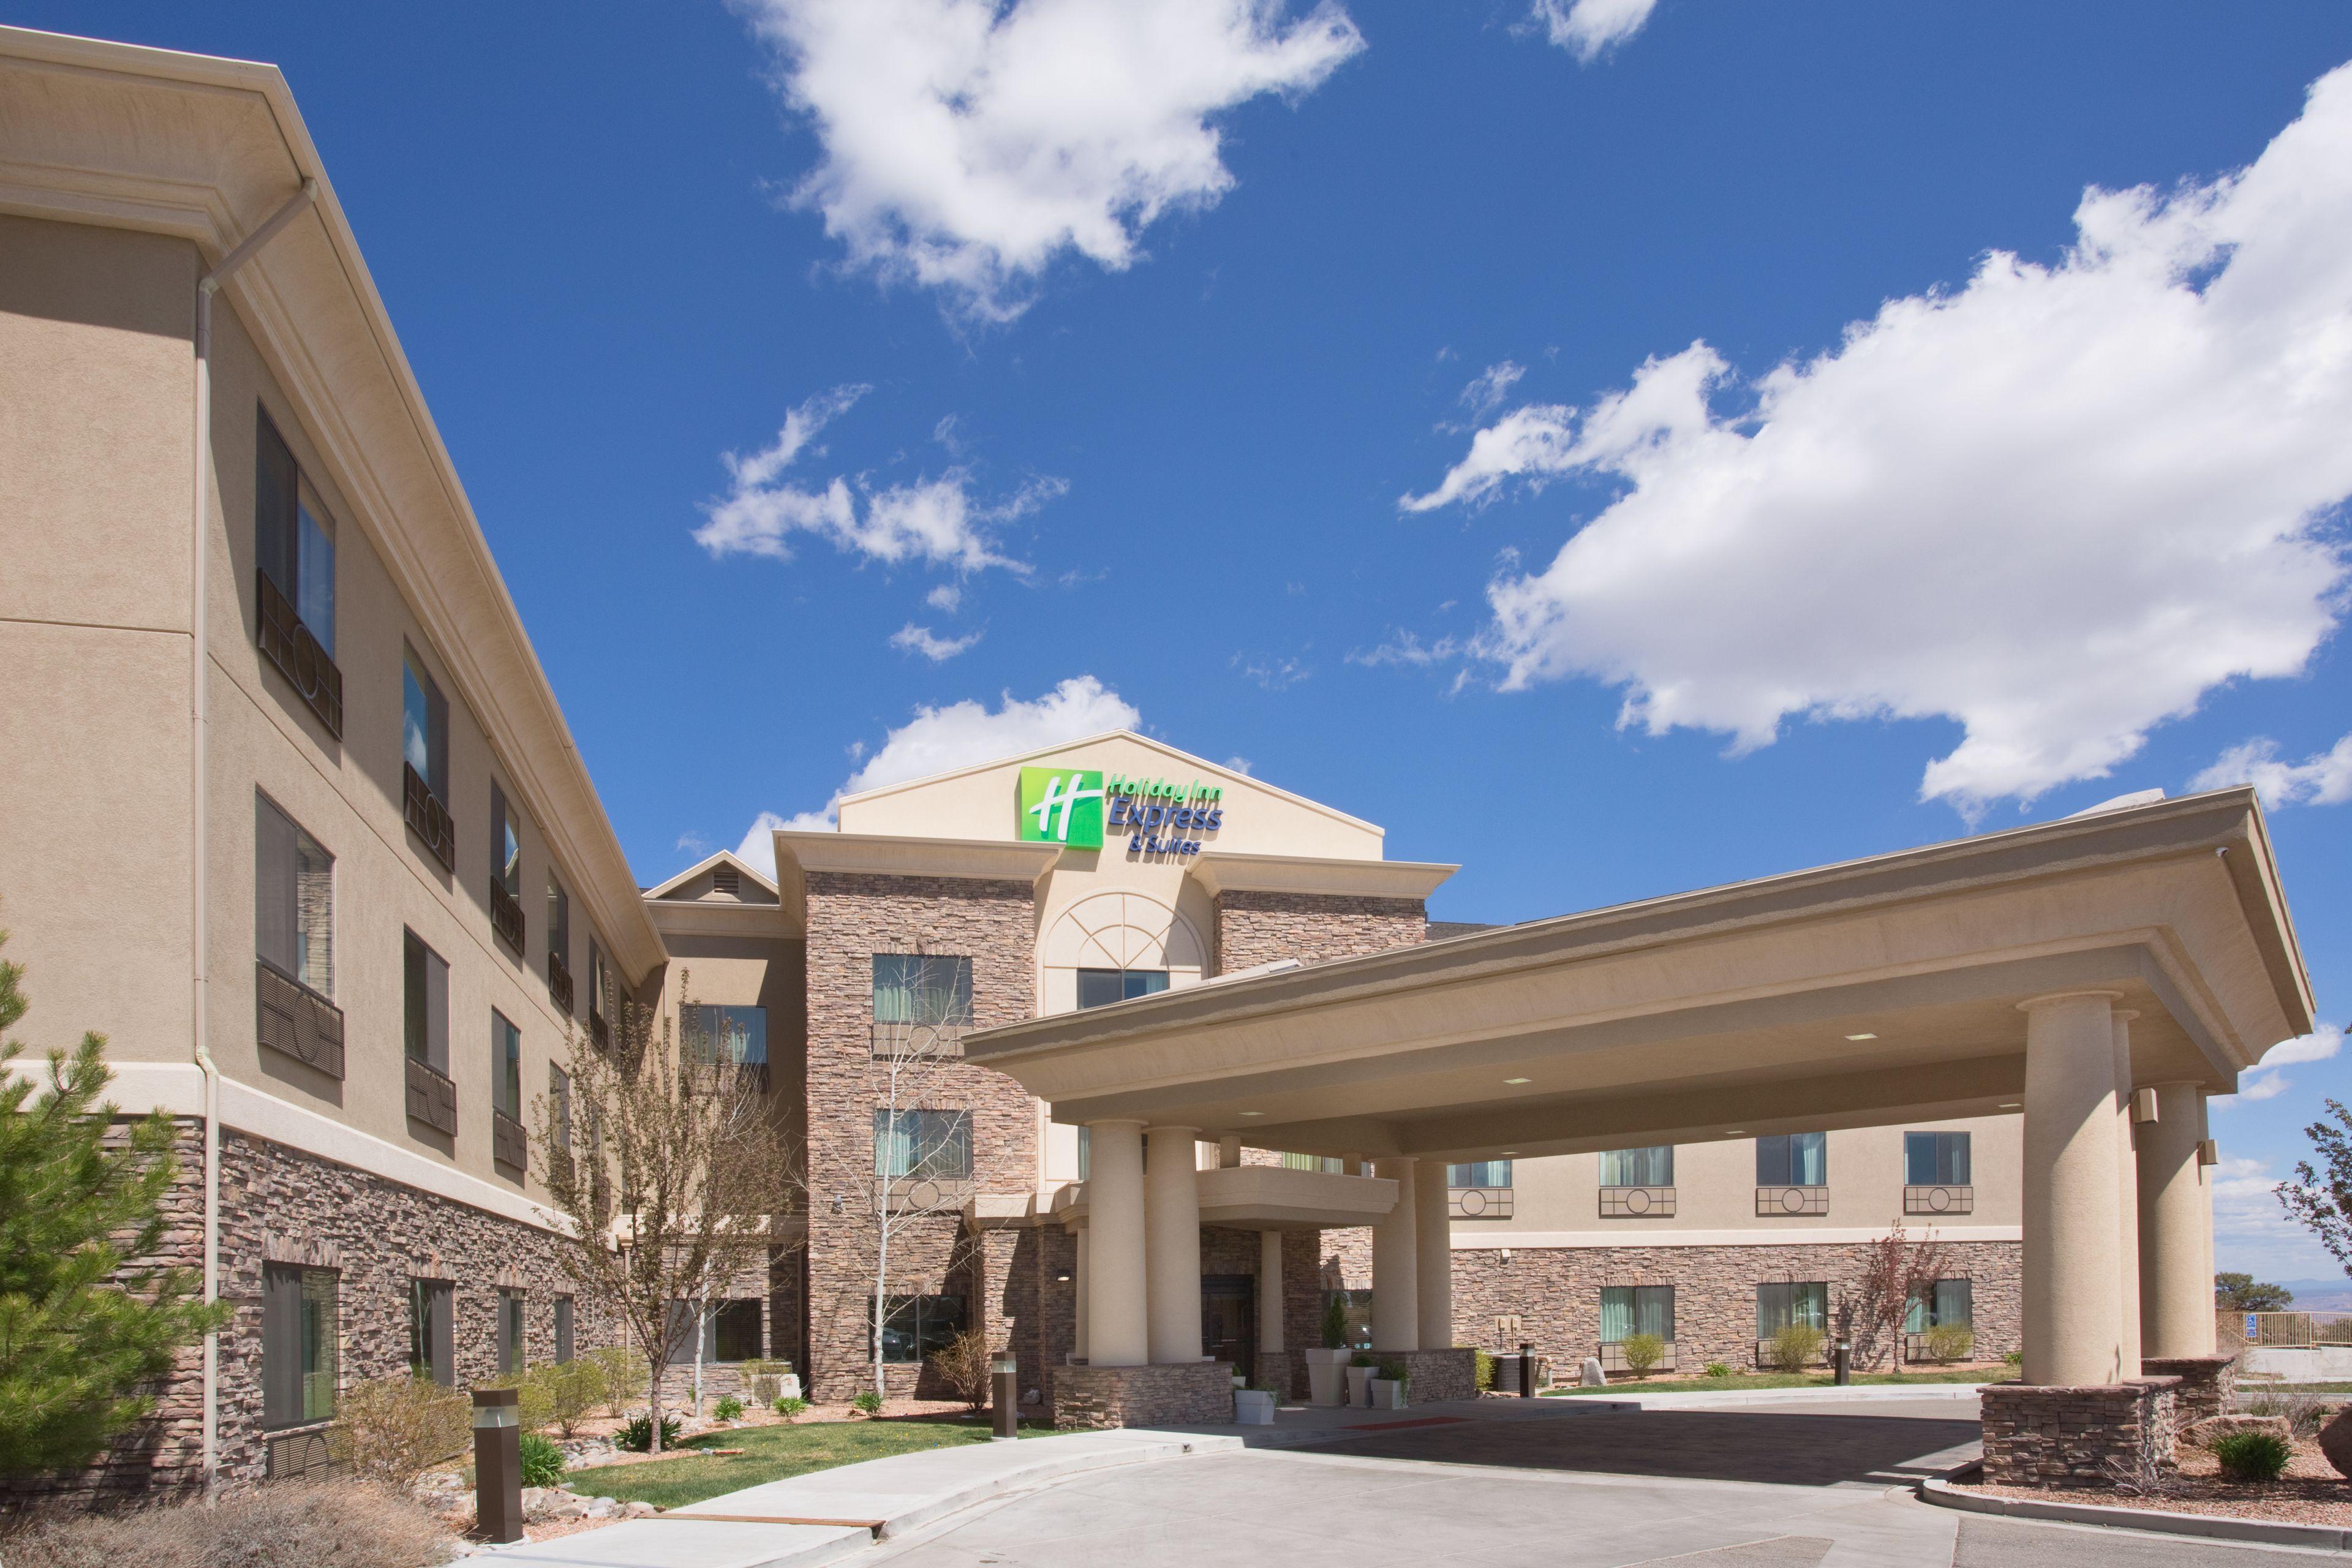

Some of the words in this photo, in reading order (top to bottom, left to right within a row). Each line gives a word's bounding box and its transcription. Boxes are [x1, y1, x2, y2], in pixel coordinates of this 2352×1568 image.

[1108, 774, 1188, 803] Holiday
[1191, 779, 1223, 801] Inn
[1108, 796, 1224, 834] Express
[1128, 833, 1142, 852] &
[1145, 834, 1202, 855] Suites
